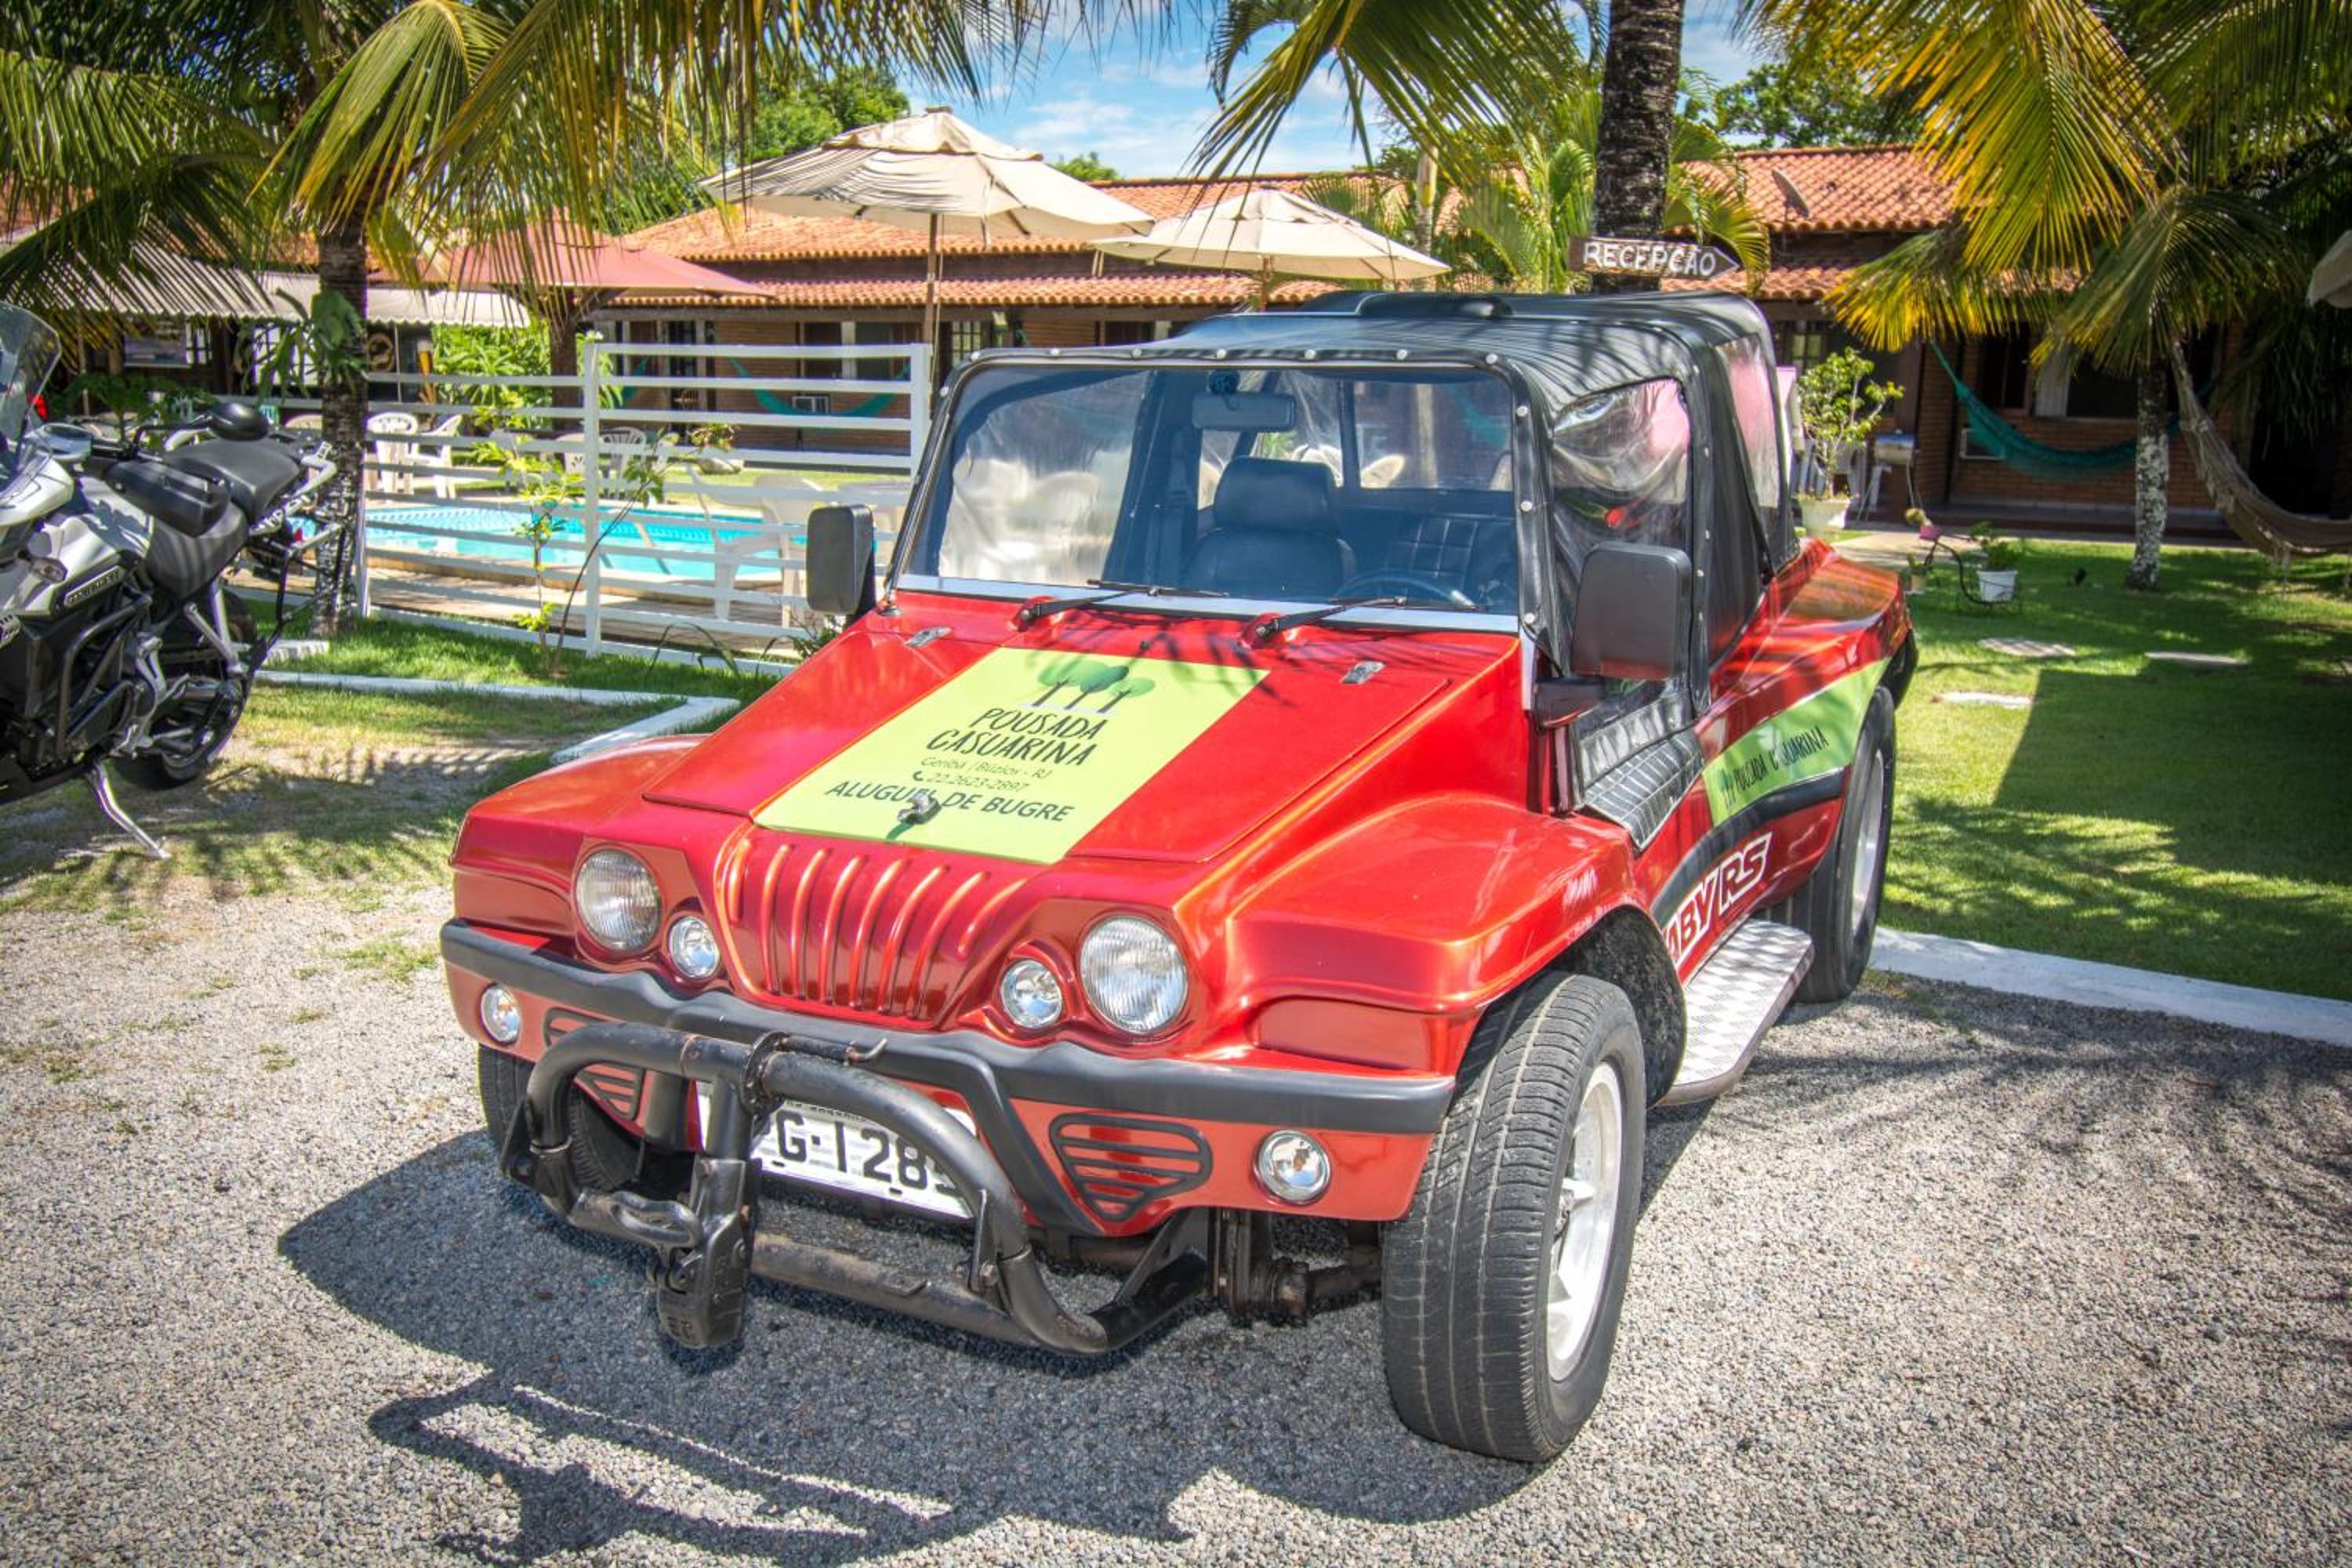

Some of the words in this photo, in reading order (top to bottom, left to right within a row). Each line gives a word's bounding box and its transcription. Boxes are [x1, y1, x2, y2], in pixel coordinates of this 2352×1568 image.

[968, 707, 1109, 739] POUSADA
[926, 728, 1098, 766] CASUARINA
[1769, 724, 1829, 771] CUARINA
[942, 791, 982, 811] DE
[981, 797, 1075, 822] BUGRE
